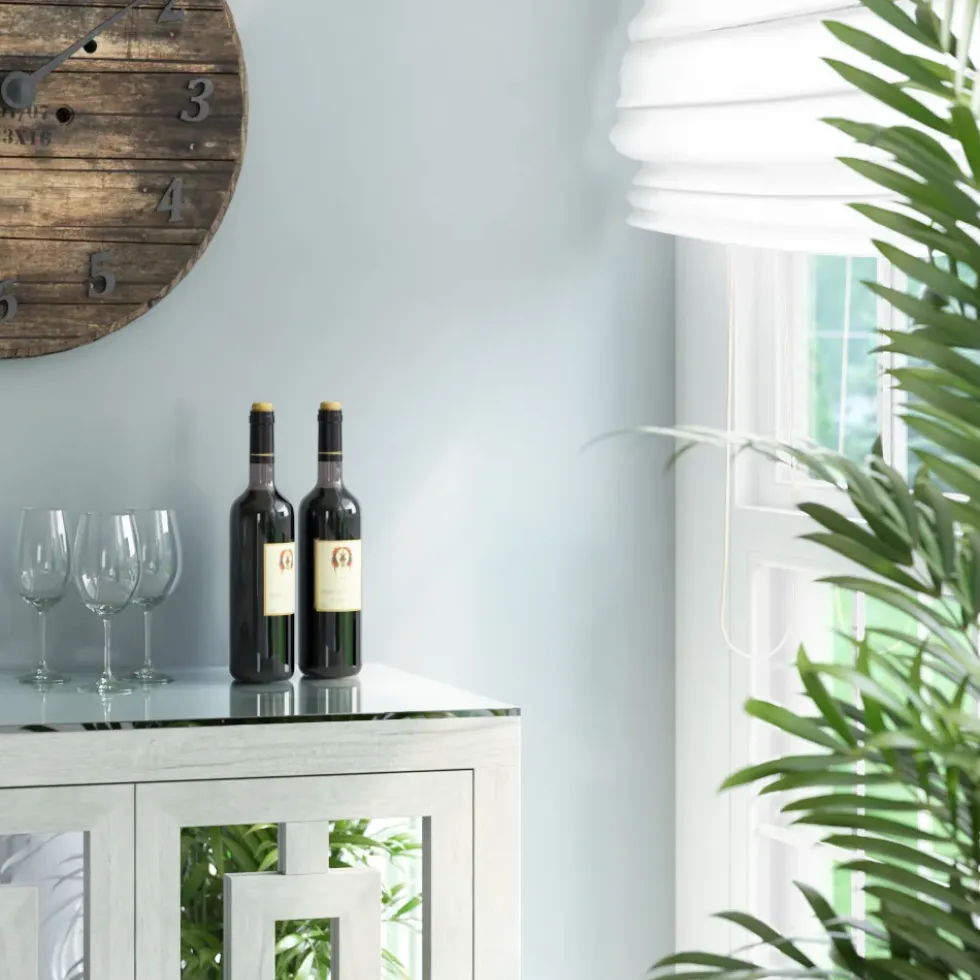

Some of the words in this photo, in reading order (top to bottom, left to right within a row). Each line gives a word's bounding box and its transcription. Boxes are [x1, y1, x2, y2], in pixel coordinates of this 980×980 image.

[180, 79, 214, 123] 3
[157, 177, 186, 223] 4
[87, 252, 116, 299] 5
